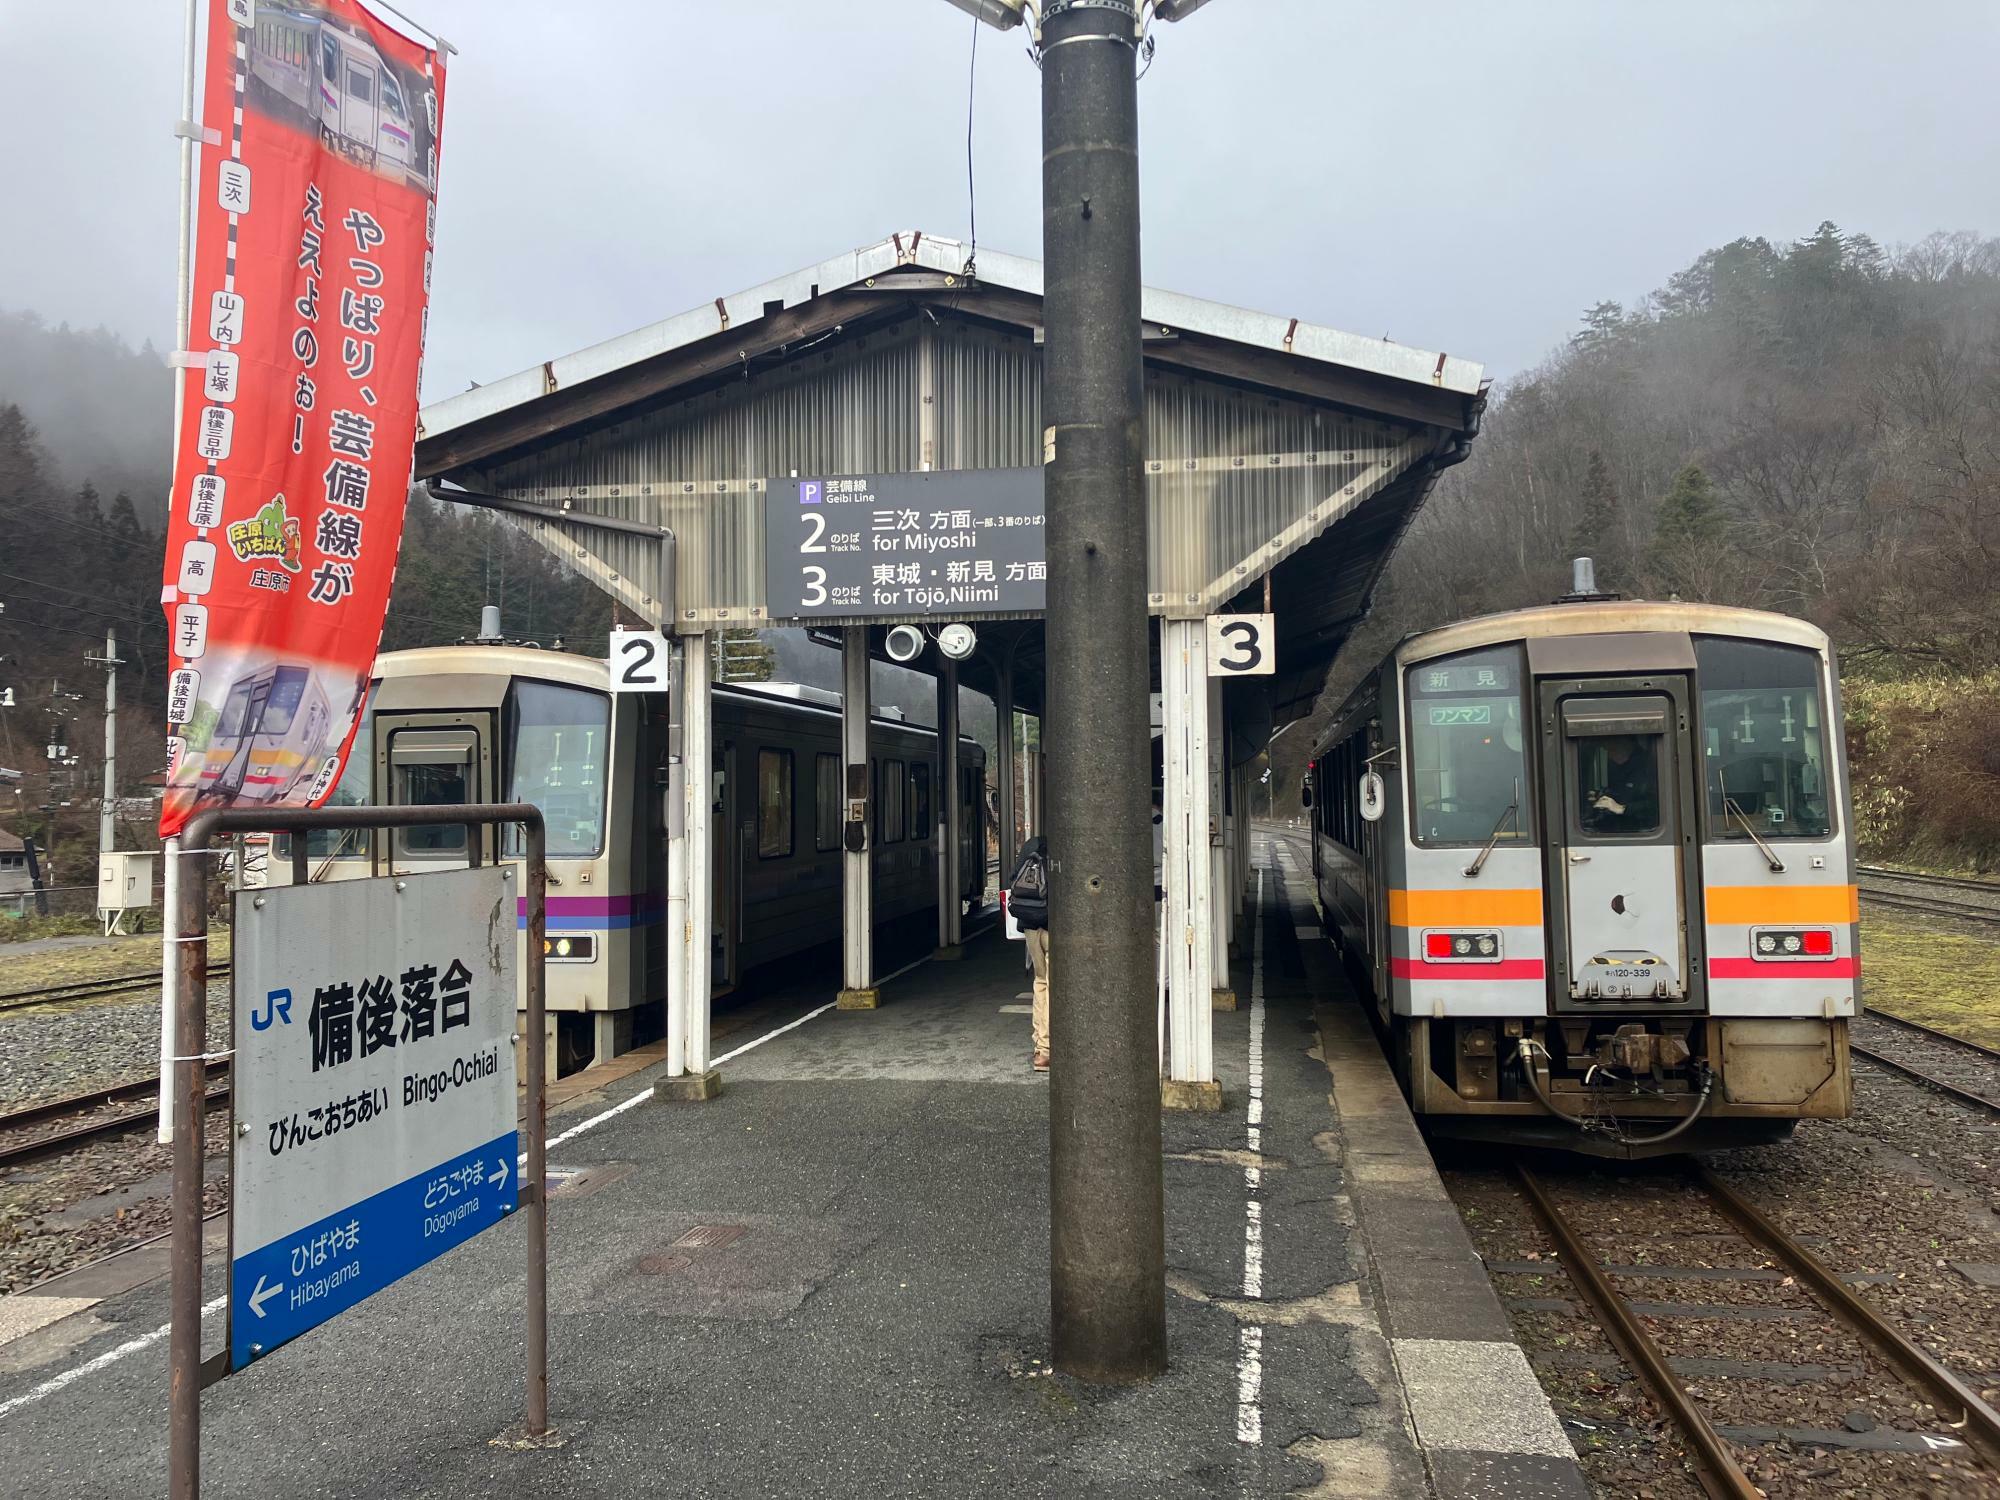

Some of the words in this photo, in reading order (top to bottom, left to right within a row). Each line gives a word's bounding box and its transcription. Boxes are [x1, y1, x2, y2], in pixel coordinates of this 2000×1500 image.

[225, 171, 243, 204] 三次
[216, 295, 236, 341] 山ノ内
[210, 360, 230, 392] 七塚
[310, 210, 383, 603] やっぱり、芸備線が
[204, 408, 226, 457] 備後三日市
[193, 476, 217, 526] 備後庄原
[805, 484, 817, 501] P
[825, 479, 868, 493] 芸備線
[826, 493, 852, 504] Geibi
[854, 493, 875, 503] Line
[230, 520, 263, 542] 庄原
[800, 512, 827, 554] 2
[872, 508, 920, 531] 三次
[929, 509, 972, 530] 方面
[830, 532, 861, 544] のりば
[830, 544, 848, 552] Track
[850, 543, 862, 552] No.
[872, 533, 899, 551] for
[905, 531, 977, 554] Miyoshi
[187, 560, 206, 576] 高
[251, 569, 291, 592] 庄原市
[1005, 560, 1047, 582] 方面
[801, 565, 828, 607] 3
[831, 586, 861, 598] のりば
[831, 597, 849, 606] Track
[850, 596, 862, 605] No.
[872, 587, 900, 605] for
[904, 584, 999, 608] Tōjō,Niimi
[181, 615, 200, 647] 平子
[1219, 621, 1262, 672] 3
[621, 638, 657, 684] 2
[169, 672, 192, 722] 備後西城
[1432, 708, 1487, 723] ワンマン
[251, 988, 293, 1032] JR
[308, 958, 473, 1073] 備後落合
[403, 1046, 498, 1107] Bingo-Ochiai
[268, 1086, 388, 1157] びんごおちあい
[423, 1158, 485, 1209] どうごやま
[424, 1196, 480, 1239] Dōgoyama
[290, 1218, 361, 1278] ひばやま
[289, 1259, 361, 1311] Hibayama
